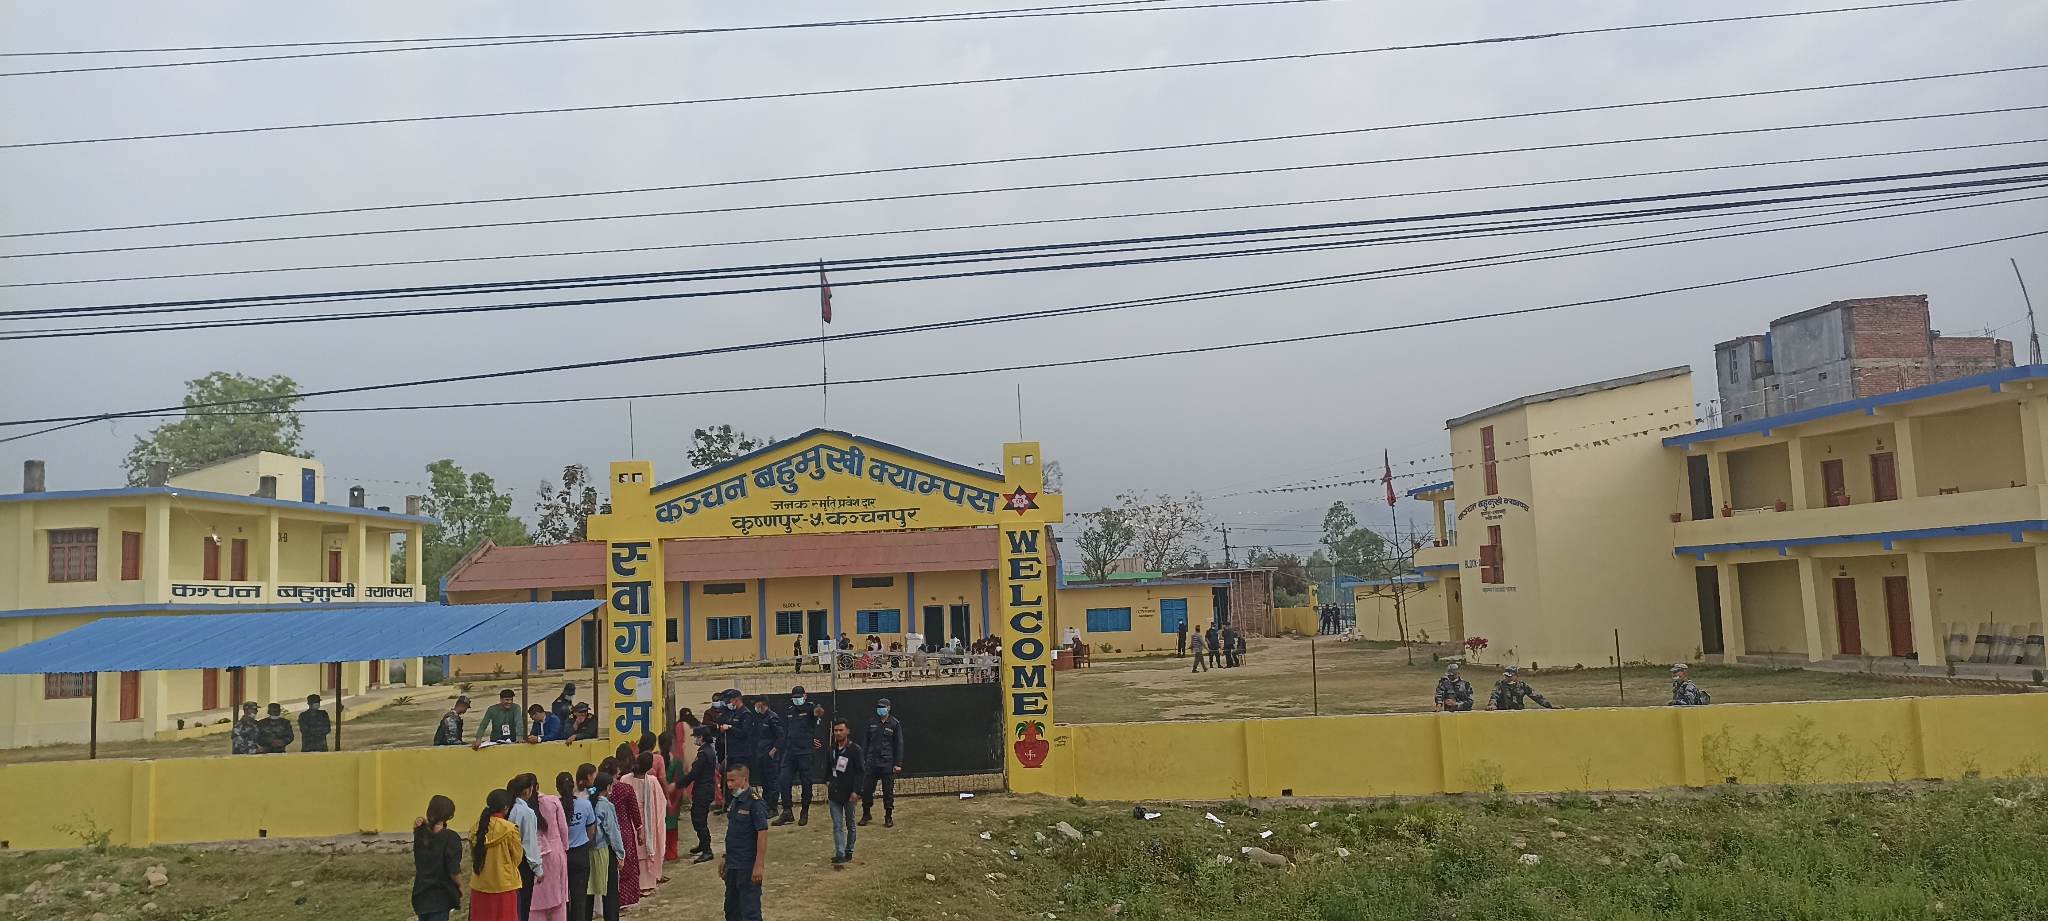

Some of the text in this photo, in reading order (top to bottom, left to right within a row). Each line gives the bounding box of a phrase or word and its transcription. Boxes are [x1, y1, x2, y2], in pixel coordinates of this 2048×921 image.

[655, 444, 999, 523] कञ्चन बहुमुखी क्याम्पस
[770, 500, 810, 510] जनक
[825, 508, 920, 528] कञ्चनपुर
[277, 583, 355, 602] बहुमुखी
[365, 586, 413, 598] क्याम्पस
[1006, 530, 1048, 716] WELCOME
